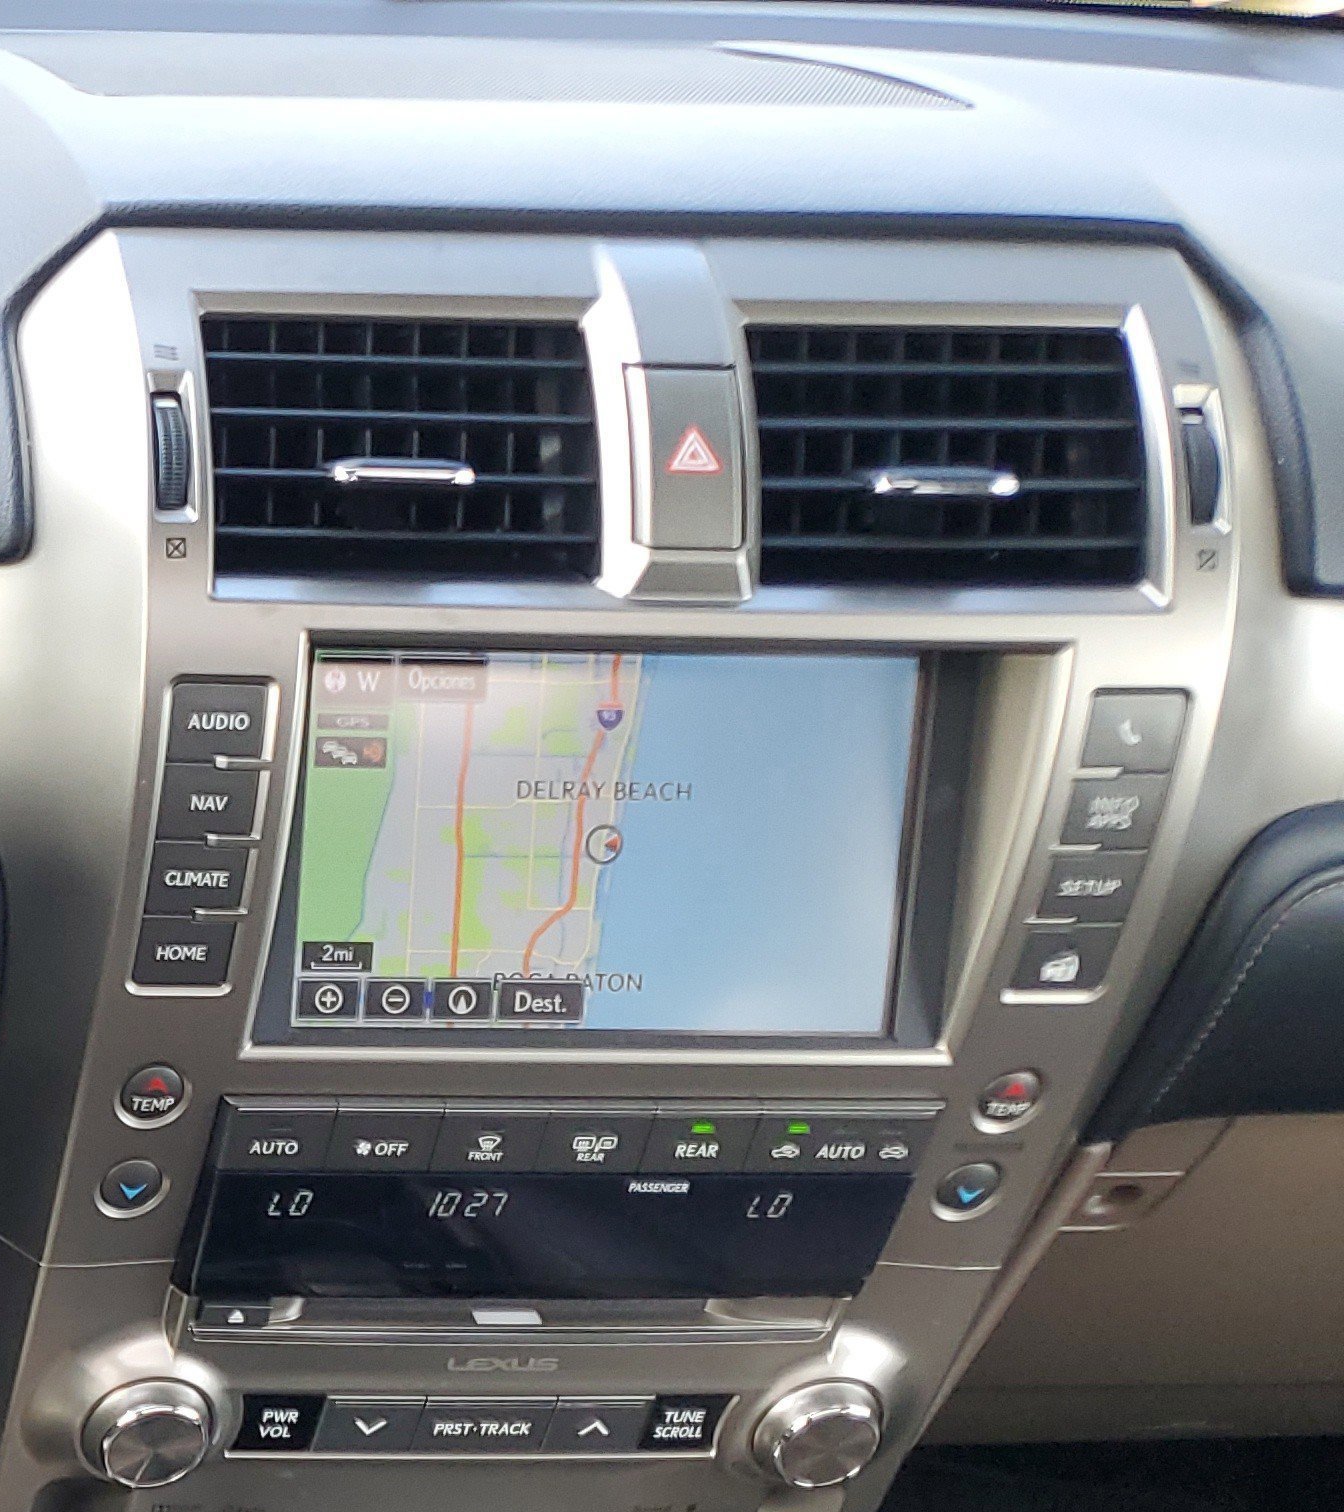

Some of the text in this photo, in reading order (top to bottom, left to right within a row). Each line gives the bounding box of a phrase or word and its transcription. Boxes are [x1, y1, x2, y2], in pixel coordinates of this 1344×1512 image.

[356, 670, 381, 693] W
[187, 712, 251, 731] AUDIO
[516, 779, 693, 802] DELRAY BEACH
[189, 794, 228, 813] NAV
[164, 870, 230, 888] CLIMATE
[155, 944, 208, 962] HOME
[513, 989, 568, 1015] Dest.
[131, 1095, 176, 1114] TEMP
[248, 1139, 300, 1156] AUTO
[374, 1141, 410, 1158] OFF
[674, 1141, 719, 1159] REAR
[815, 1142, 866, 1160] AUTO
[467, 1150, 504, 1163] FRONT
[576, 1151, 606, 1163] REAR
[627, 1179, 691, 1194] PASSENGER
[446, 1355, 560, 1372] LEXUS
[262, 1409, 299, 1423] PWR
[664, 1410, 706, 1425] TUNE
[258, 1423, 292, 1439] VOL
[652, 1424, 703, 1440] SCROLL
